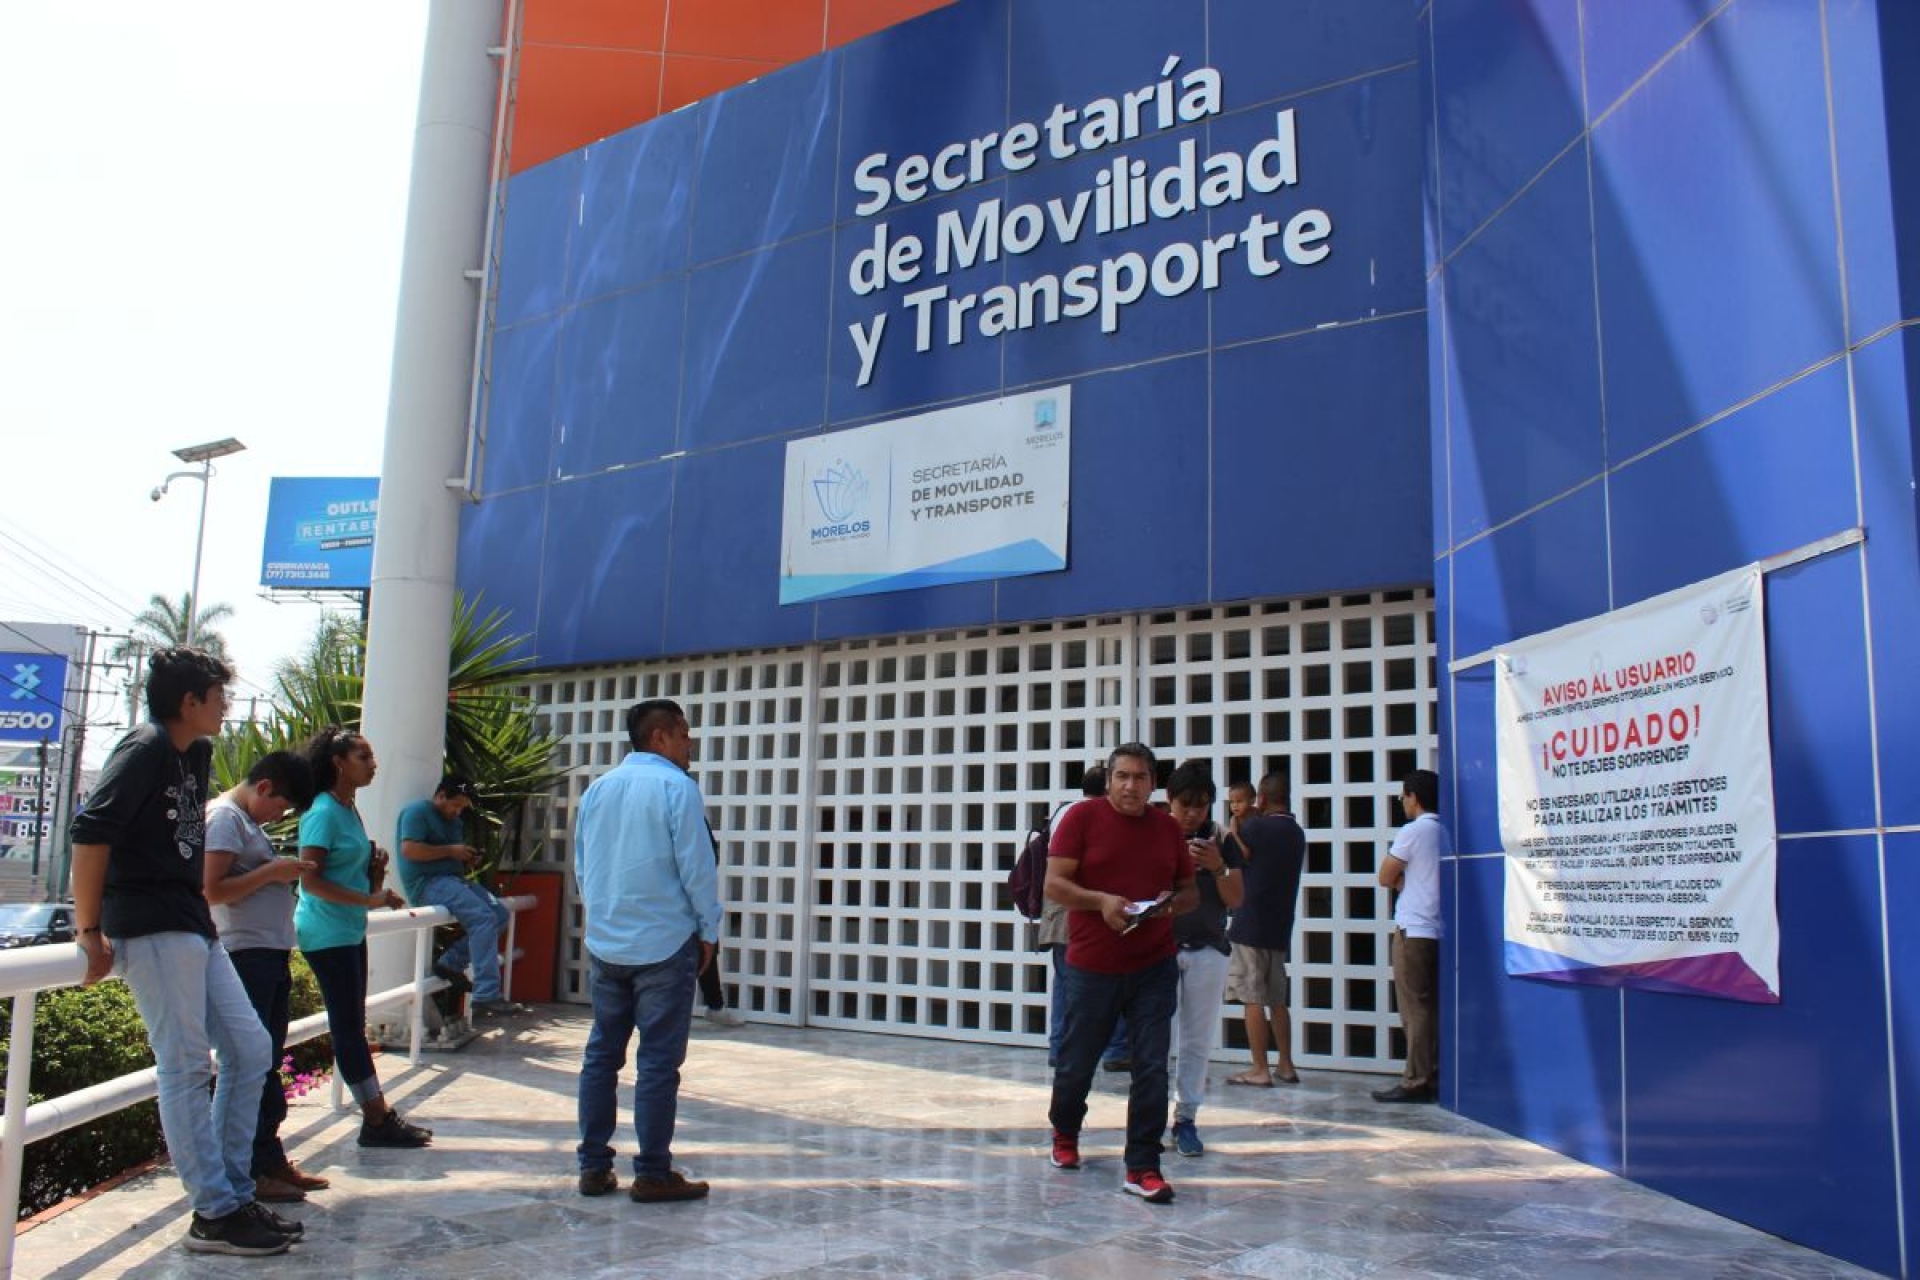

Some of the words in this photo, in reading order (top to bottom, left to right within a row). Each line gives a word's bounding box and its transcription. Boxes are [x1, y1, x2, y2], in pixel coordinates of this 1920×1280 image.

[854, 55, 1222, 217] Secretaría
[849, 224, 923, 296] de
[934, 109, 1298, 275] Movilidad
[849, 313, 887, 387] y
[904, 208, 1333, 353] Transporte
[911, 453, 1008, 485] SECRETARÍA
[911, 487, 931, 502] DE
[935, 472, 1025, 498] MOVILIDAD
[911, 508, 922, 522] Y
[925, 490, 1035, 519] TRANSPORTE
[810, 520, 871, 540] MORELOS
[1543, 678, 1588, 706] AVISO
[1592, 671, 1612, 695] AL
[1615, 650, 1697, 689] USUARIO
[1543, 704, 1701, 771] ¡CUIDADO!
[1552, 760, 1567, 778] NO
[1567, 758, 1581, 776] TE
[1583, 754, 1616, 776] DEJES
[1617, 744, 1690, 770] SORPRENDER
[1526, 799, 1538, 811] NO
[1539, 797, 1551, 810] ES
[1552, 792, 1600, 809] NECESARIO
[1600, 787, 1641, 804] UTILIZAR
[1643, 786, 1650, 800] A
[1652, 783, 1670, 799] LOS
[1671, 775, 1728, 796] GESTORES
[1534, 812, 1564, 827] PARA
[1566, 806, 1622, 825] REALIZAR
[1624, 803, 1648, 819] LOS
[1619, 842, 1664, 855] TRANSPORTE
[1666, 841, 1683, 852] SON
[1685, 837, 1736, 851] TOTALMENTE
[1640, 827, 1688, 841] SERVIDORES
[1724, 822, 1737, 835] EN
[1651, 855, 1664, 866] NO
[1666, 854, 1677, 865] TE
[1588, 893, 1607, 903] PARA
[1608, 893, 1623, 903] QUE
[1675, 879, 1703, 890] ACUDE
[1704, 878, 1722, 890] CON
[1619, 928, 1631, 940] 777
[1635, 915, 1676, 927] RESPECTO
[1677, 916, 1688, 928] AL
